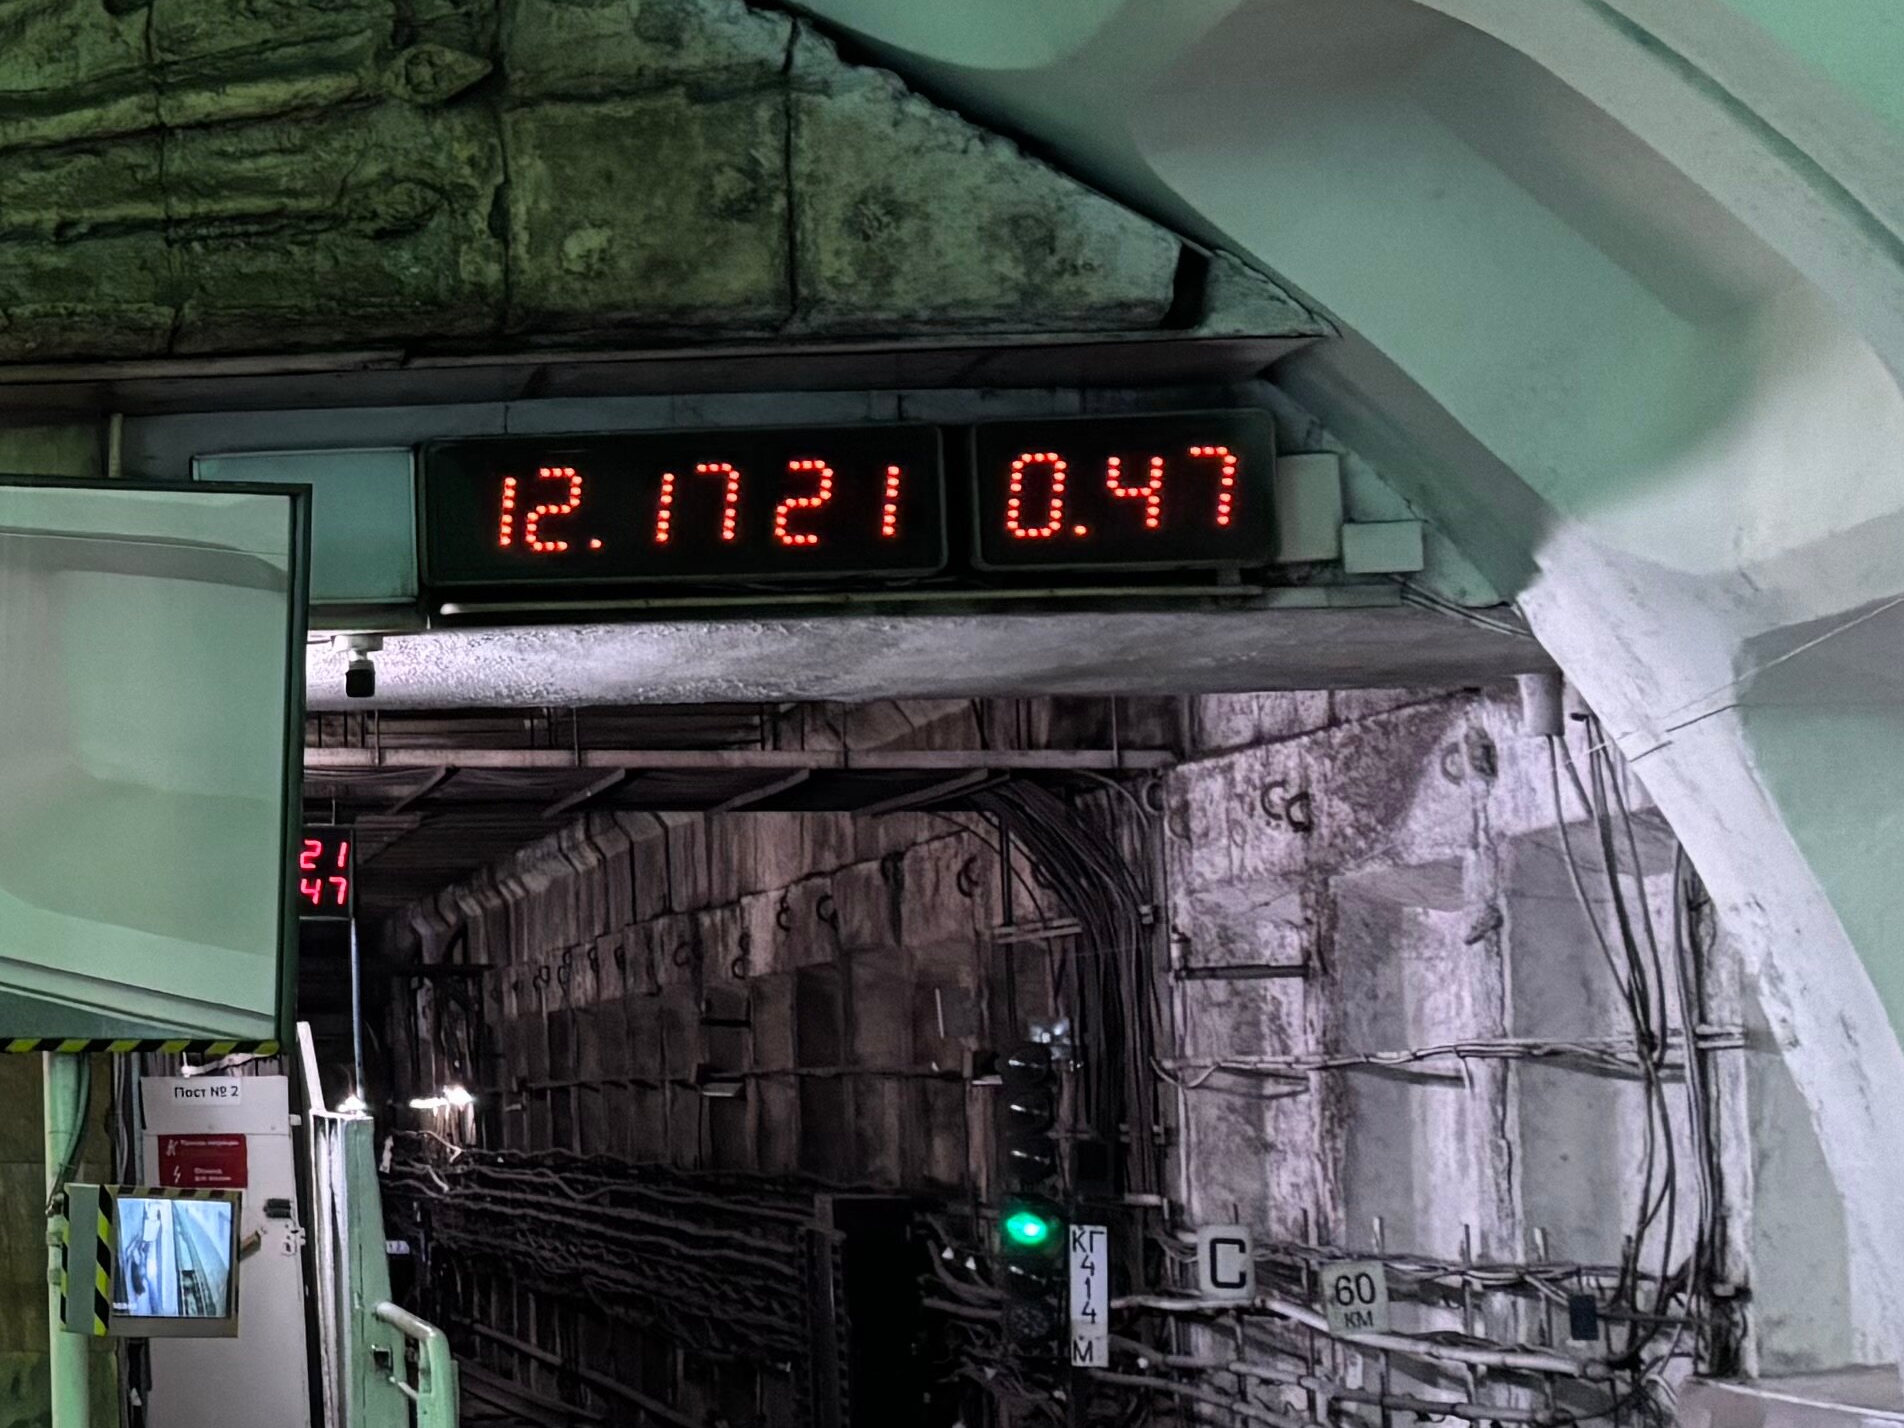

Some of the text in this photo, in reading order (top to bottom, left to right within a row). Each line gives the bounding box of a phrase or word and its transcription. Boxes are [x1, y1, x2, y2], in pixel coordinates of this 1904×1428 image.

[1005, 443, 1239, 539] 0.47
[174, 1085, 239, 1099] Пост № 2
[1209, 1237, 1247, 1289] С
[1334, 1272, 1376, 1307] 60
